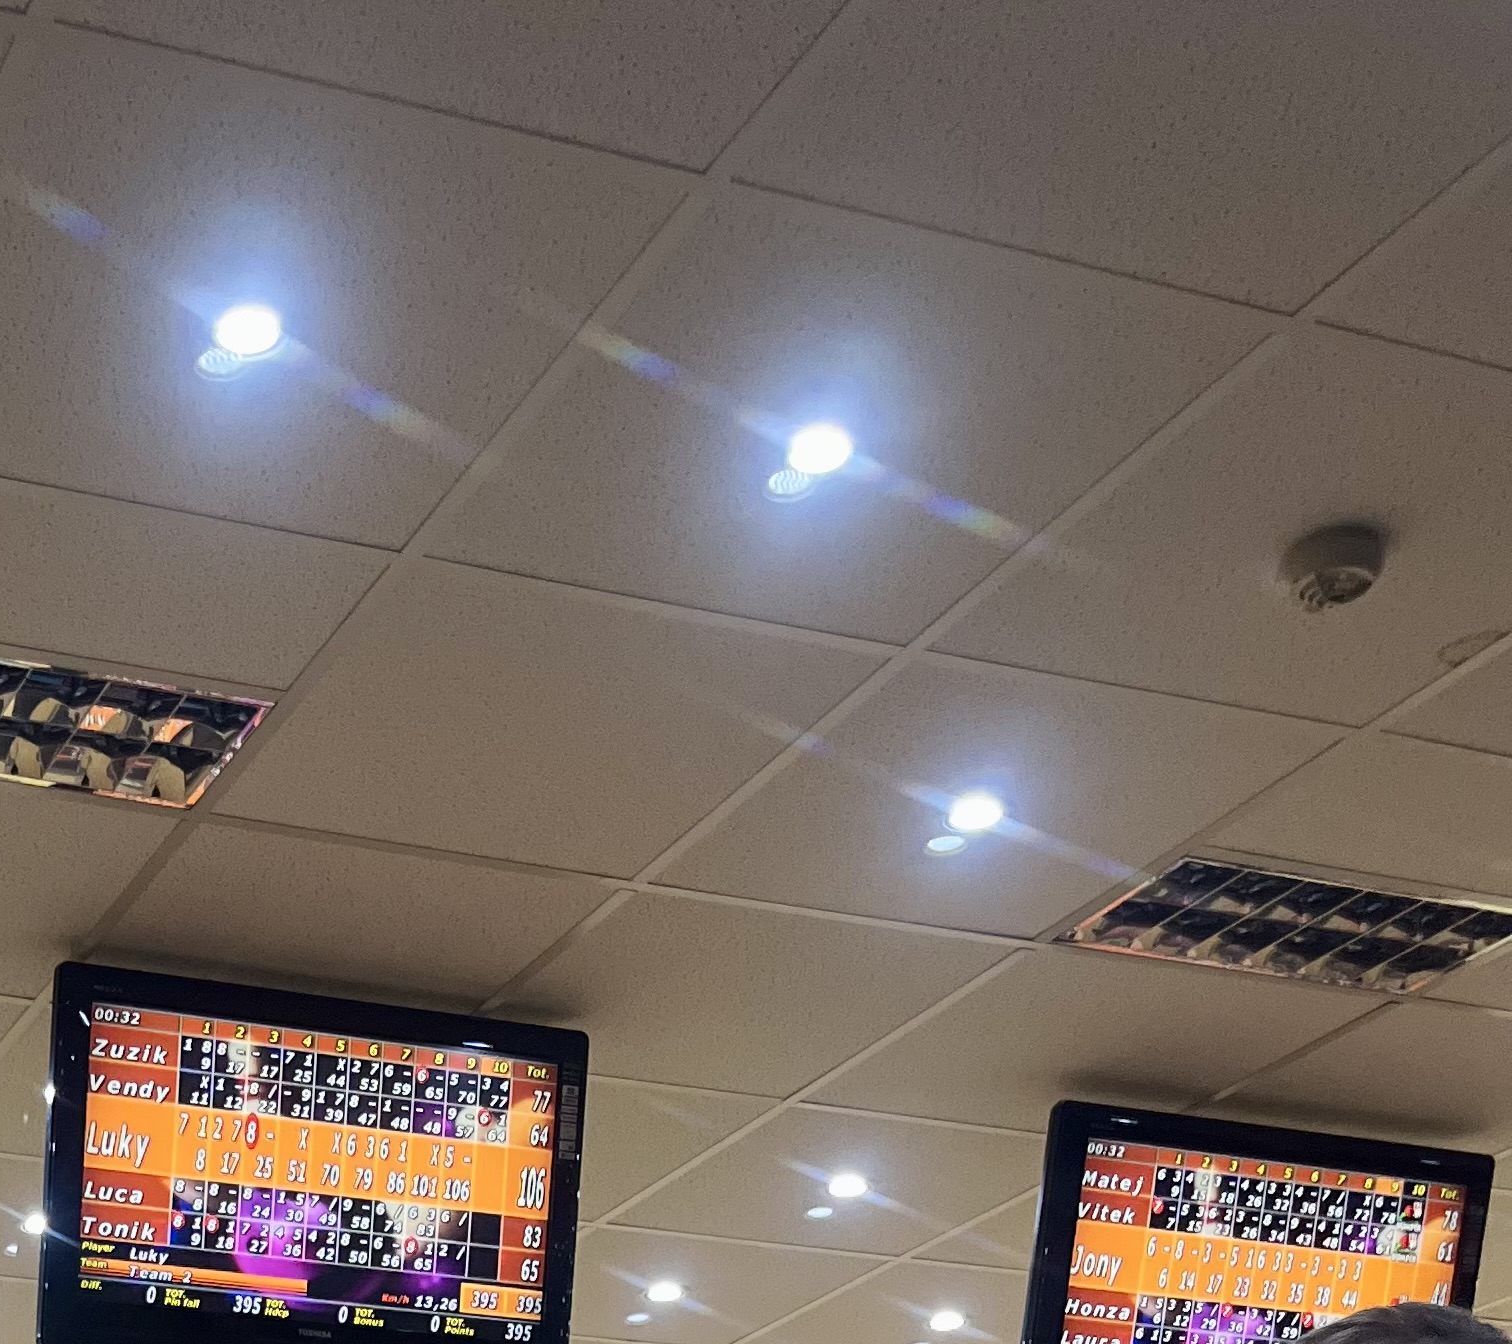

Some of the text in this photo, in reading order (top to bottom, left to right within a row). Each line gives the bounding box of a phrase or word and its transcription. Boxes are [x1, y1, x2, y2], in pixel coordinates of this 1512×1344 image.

[94, 1007, 141, 1025] 00:32
[91, 1038, 552, 1113] Zuzik 77
[526, 1065, 550, 1079] Tot.
[89, 1073, 549, 1147] Vendy 64
[86, 1120, 150, 1169] Luky
[1088, 1142, 1126, 1158] 00:32
[516, 1163, 547, 1209] 106
[1082, 1169, 1459, 1232] Matej 78
[84, 1180, 542, 1249] Luca 83
[1077, 1202, 1454, 1263] Vitek 61
[82, 1216, 540, 1282] Tonik 65
[129, 1246, 170, 1265] Luky
[1070, 1244, 1123, 1287] Jony
[129, 1264, 173, 1283] Team
[233, 1294, 262, 1315] 395
[414, 1289, 499, 1312] 13,26 395
[1064, 1298, 1132, 1321] Honza
